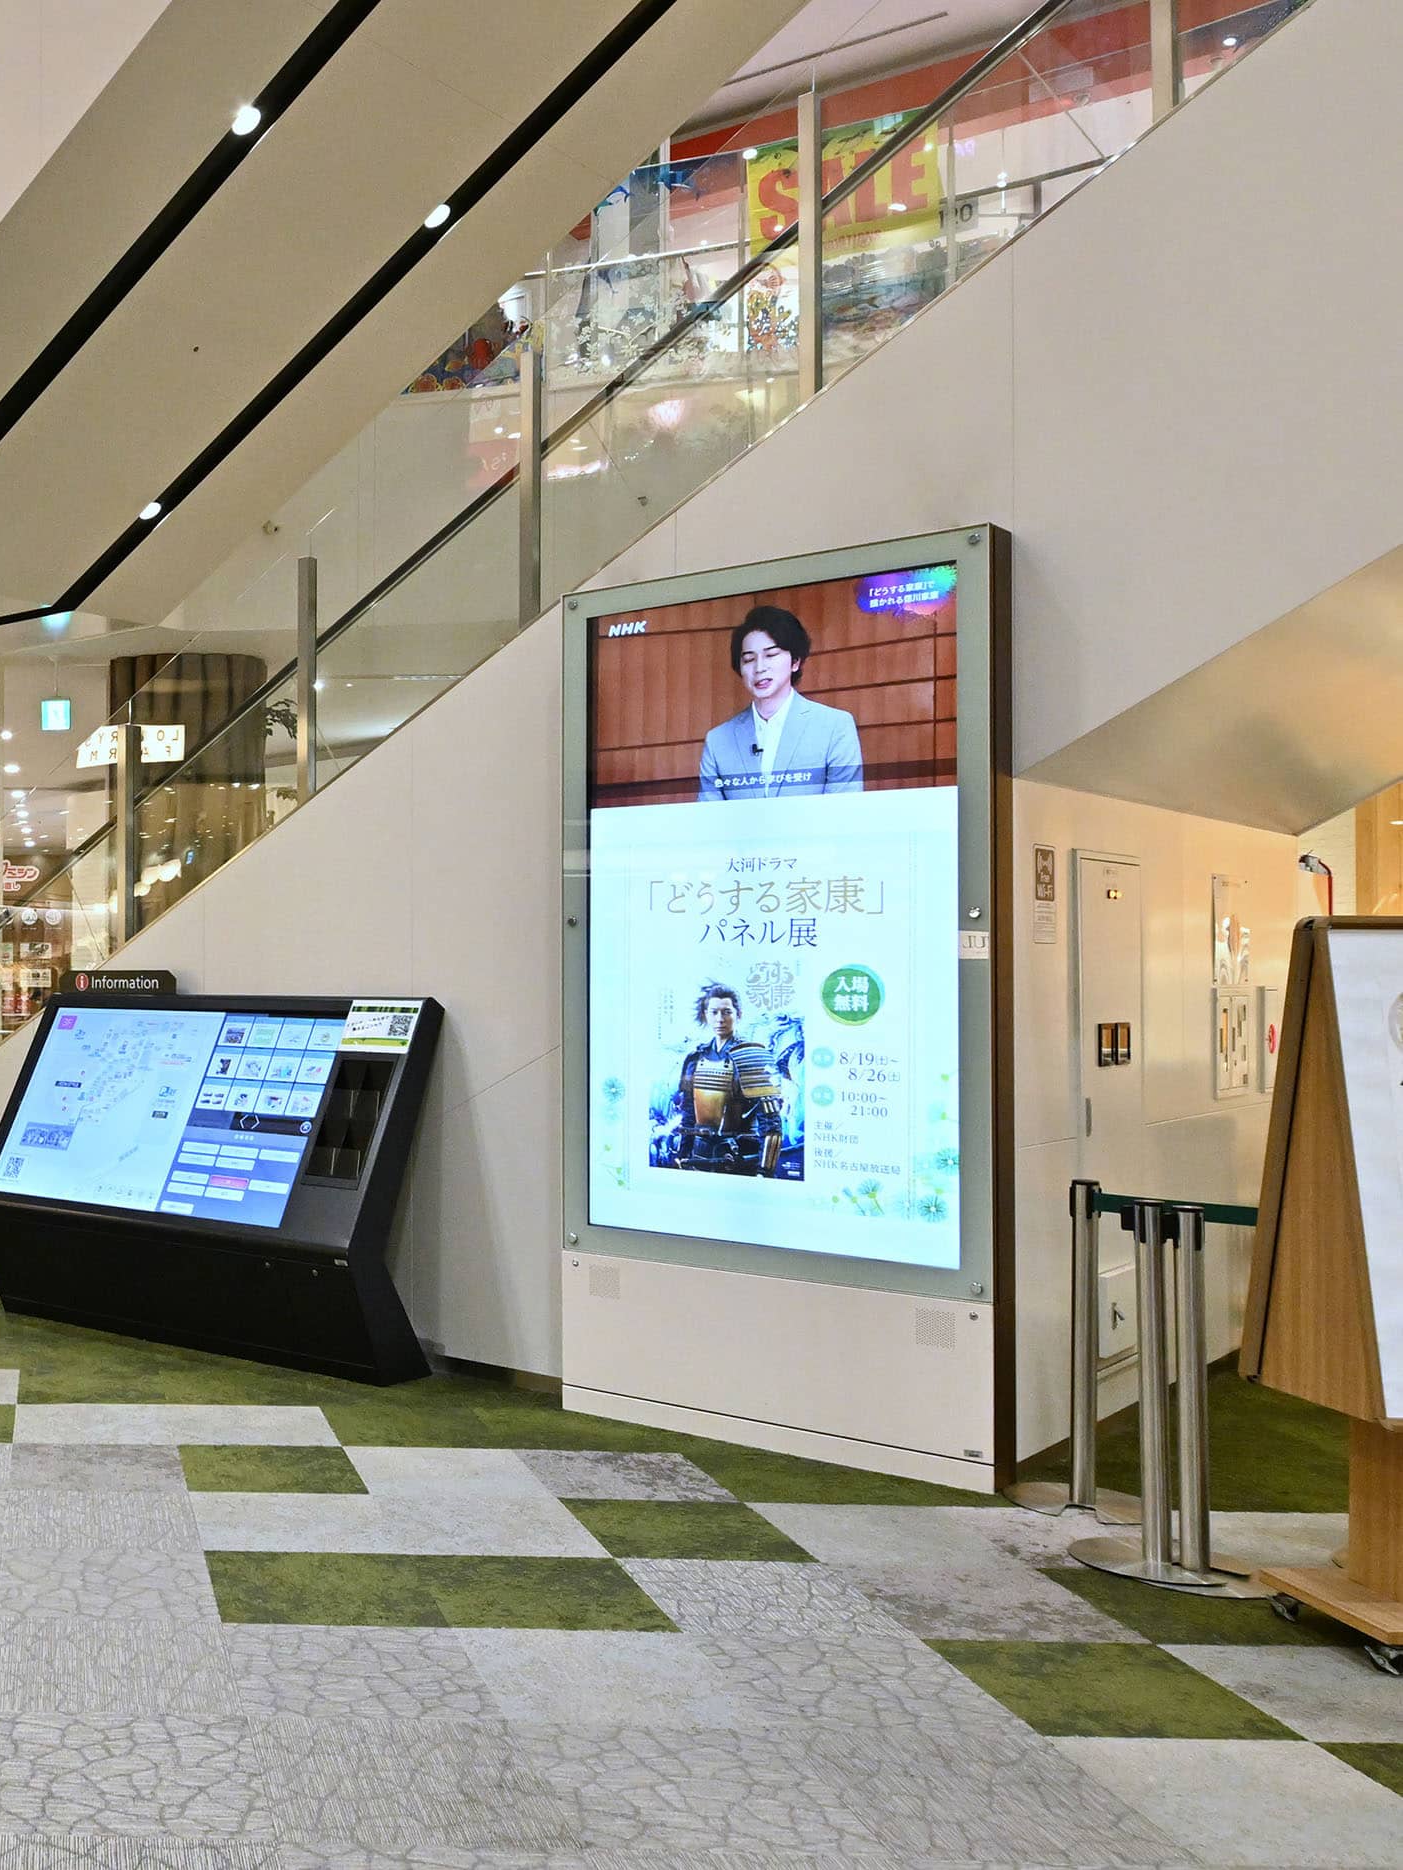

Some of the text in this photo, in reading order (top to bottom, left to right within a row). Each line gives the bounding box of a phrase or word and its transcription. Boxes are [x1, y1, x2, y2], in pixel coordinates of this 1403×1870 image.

[758, 135, 928, 241] SALE
[608, 620, 647, 637] NHK
[726, 856, 797, 873] 大河ドラマ
[648, 875, 885, 915] 「どうする家康」
[699, 917, 818, 948] パネル展
[91, 975, 159, 989] Information
[834, 976, 870, 993] 入場
[834, 994, 870, 1012] 無料
[850, 1105, 888, 1117] 21:00
